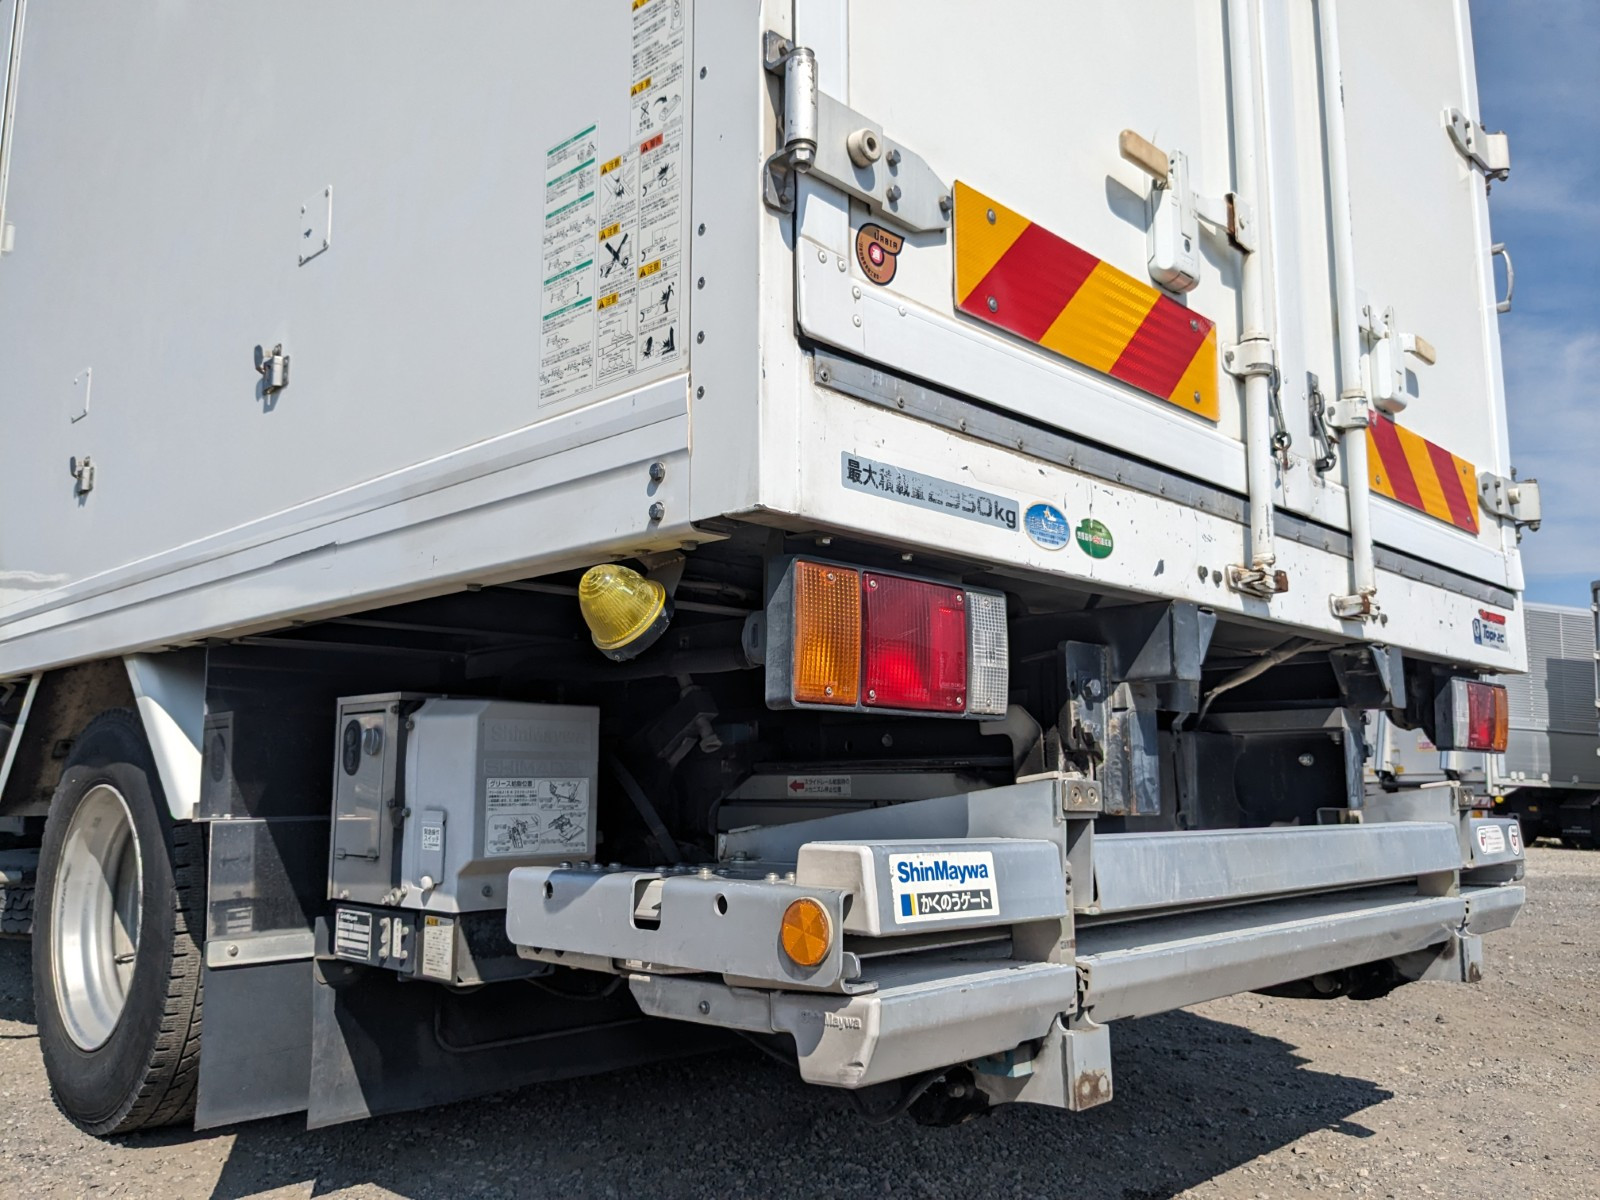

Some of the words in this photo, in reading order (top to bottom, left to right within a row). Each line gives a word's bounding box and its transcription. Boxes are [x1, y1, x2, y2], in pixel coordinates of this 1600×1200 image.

[897, 860, 989, 884] ShinMaywa
[920, 890, 990, 914] かくのうゲート
